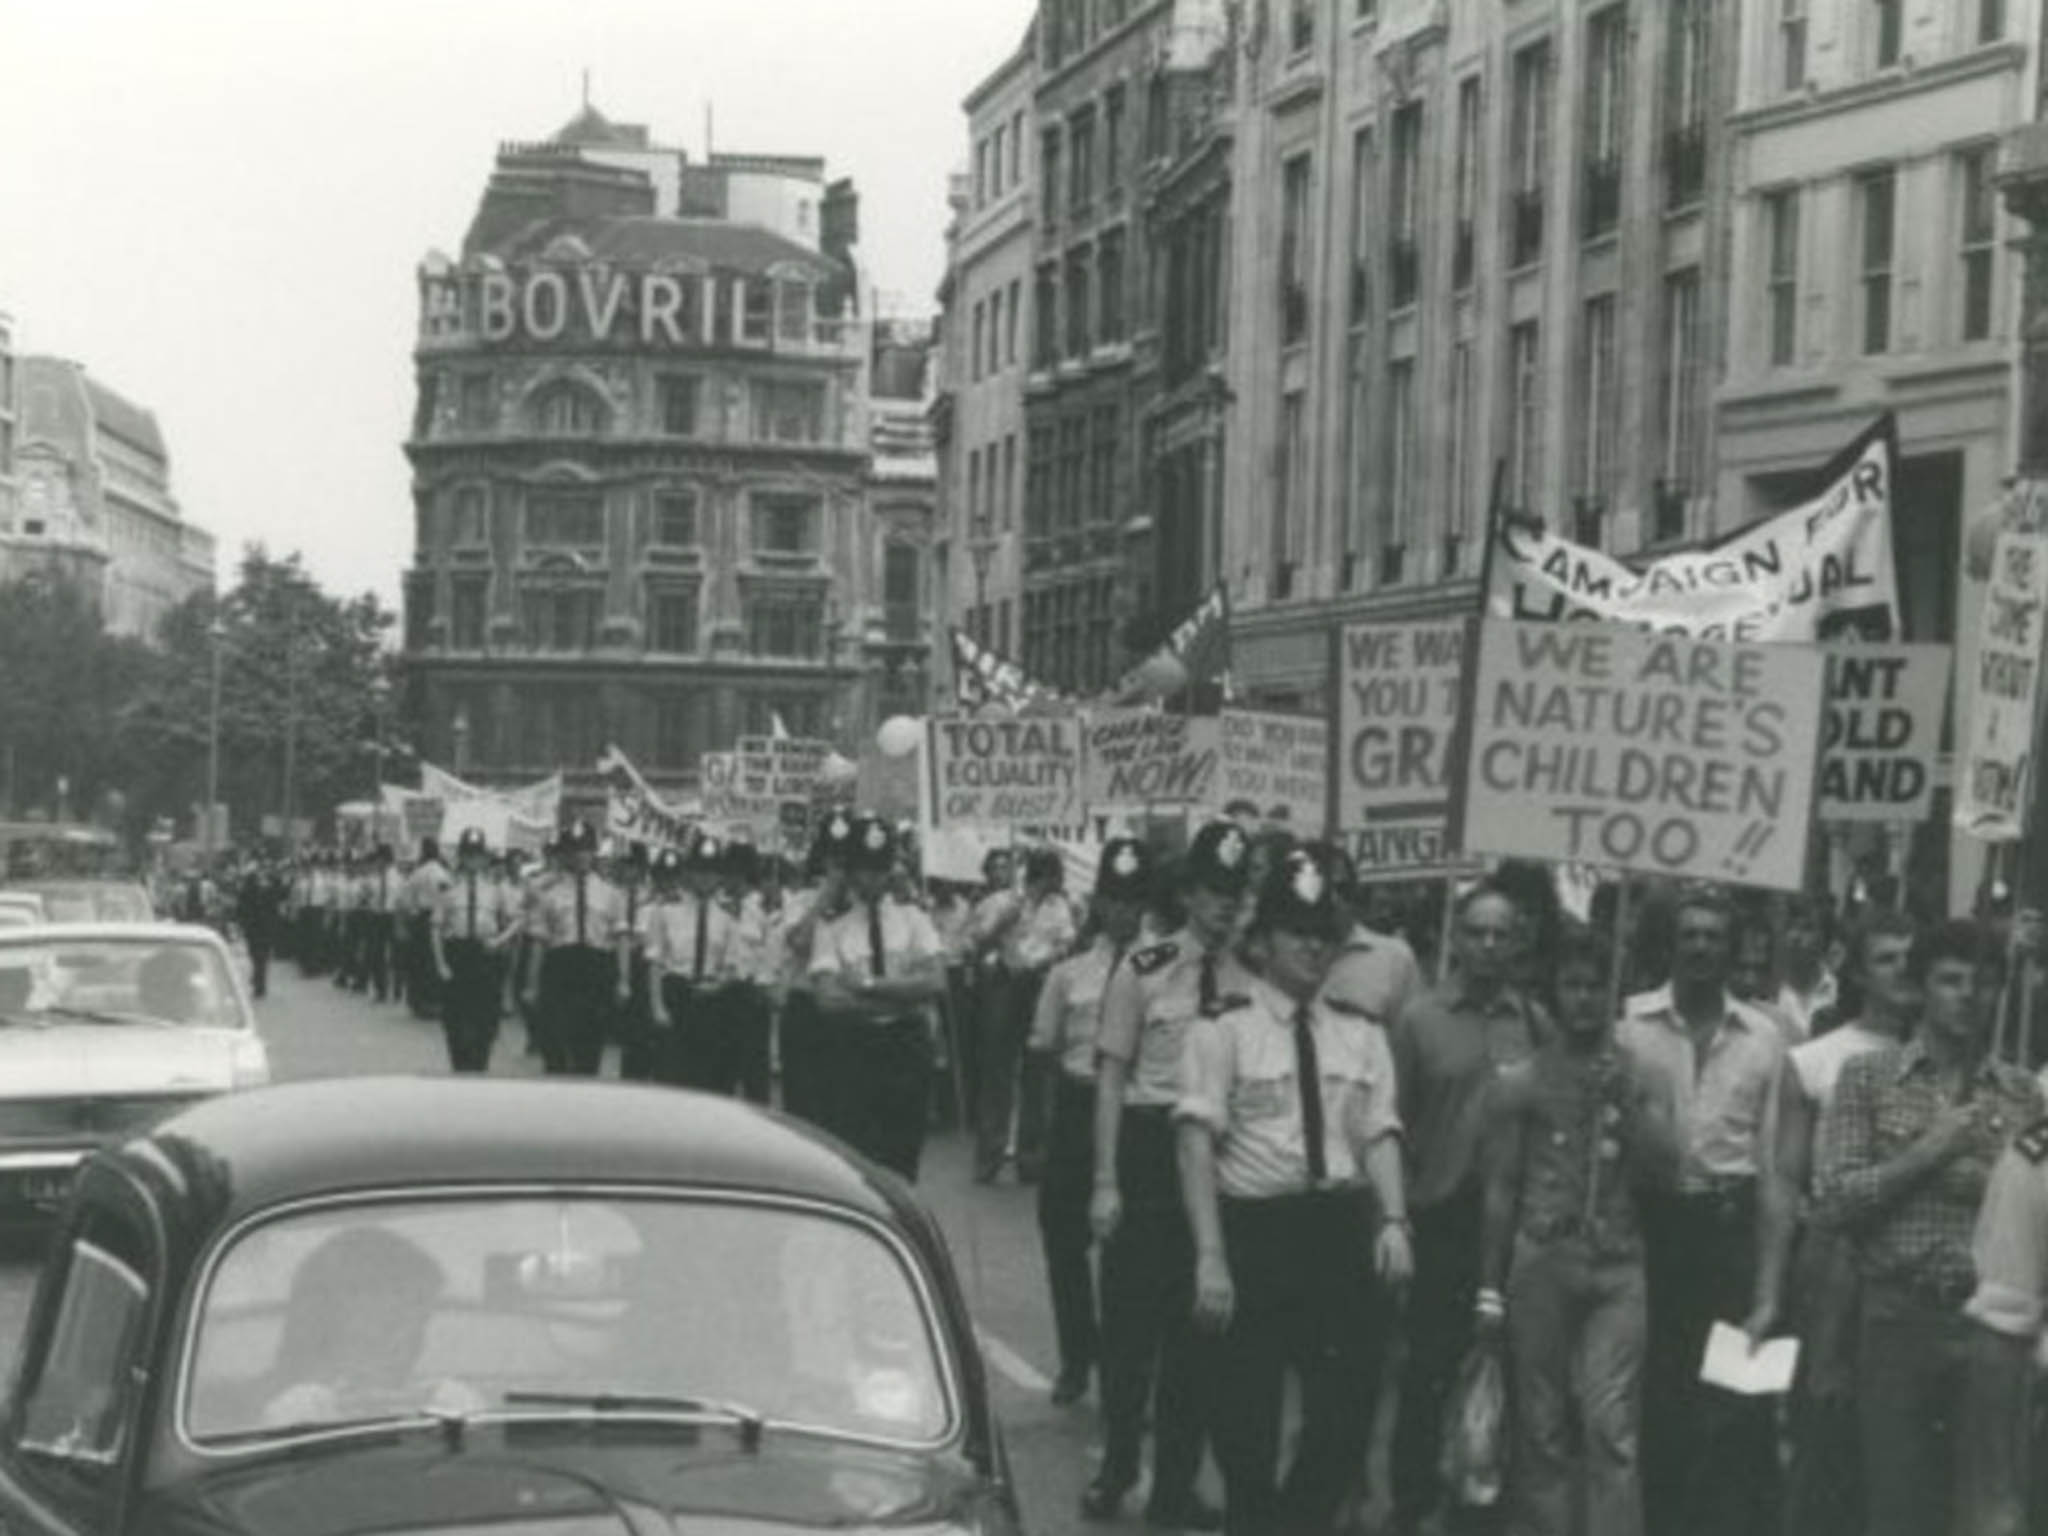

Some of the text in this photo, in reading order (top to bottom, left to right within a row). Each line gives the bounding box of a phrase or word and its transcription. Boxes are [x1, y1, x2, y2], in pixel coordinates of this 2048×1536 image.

[482, 272, 768, 347] BOVRIL
[1348, 630, 1401, 670] WE
[1517, 628, 1765, 697] WE ARE
[1351, 677, 1428, 718] YOU
[1493, 680, 1786, 758] NATURE'S
[943, 722, 1074, 758] TOTAL
[1351, 726, 1451, 789] GR
[946, 758, 1076, 787] EQUALITY
[1107, 748, 1217, 799] NOW!
[1481, 740, 1787, 819] CHILDREN
[1357, 828, 1446, 864] ANG
[1551, 806, 1698, 867] TOO
